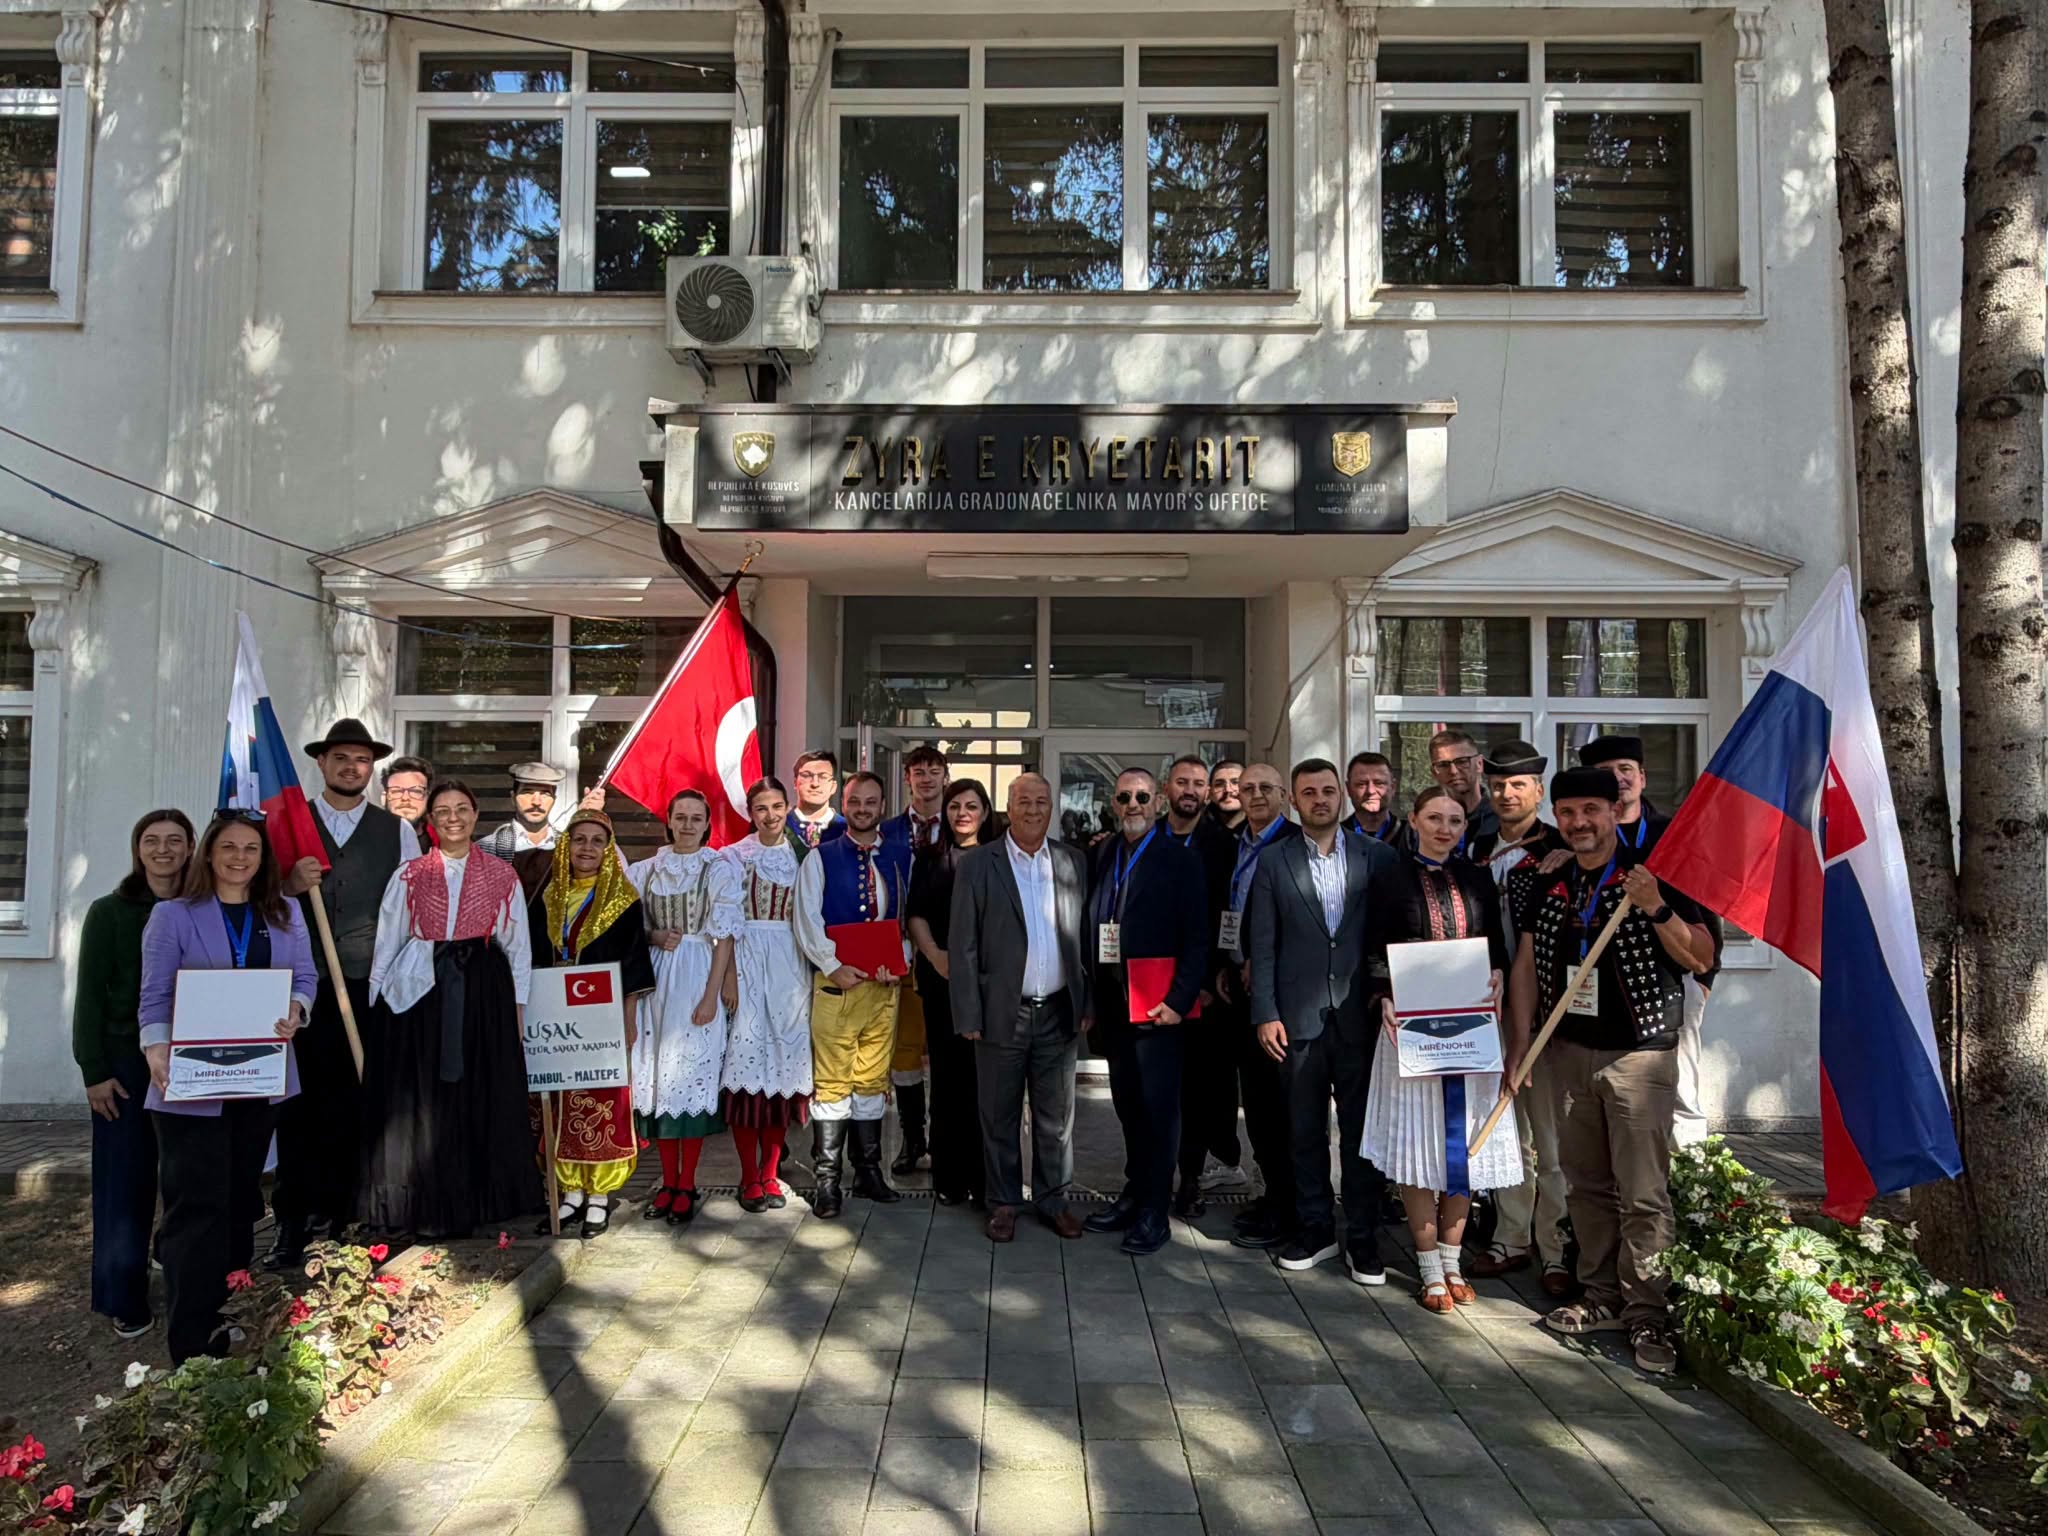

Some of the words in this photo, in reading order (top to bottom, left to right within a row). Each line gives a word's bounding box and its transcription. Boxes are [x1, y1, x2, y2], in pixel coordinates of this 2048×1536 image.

[844, 435, 952, 479] ZYRA
[978, 435, 997, 479] E
[1021, 435, 1261, 480] KRYETARIT
[834, 491, 954, 511] KANCELARIJA
[959, 488, 1117, 511] GRADONAČELNIKA
[1126, 491, 1204, 511] MAYOR'S
[1209, 491, 1269, 511] OFFICE
[525, 1045, 552, 1056] LTÜR
[528, 1072, 566, 1085] TANBUL
[574, 1068, 620, 1083] MALTEPE
